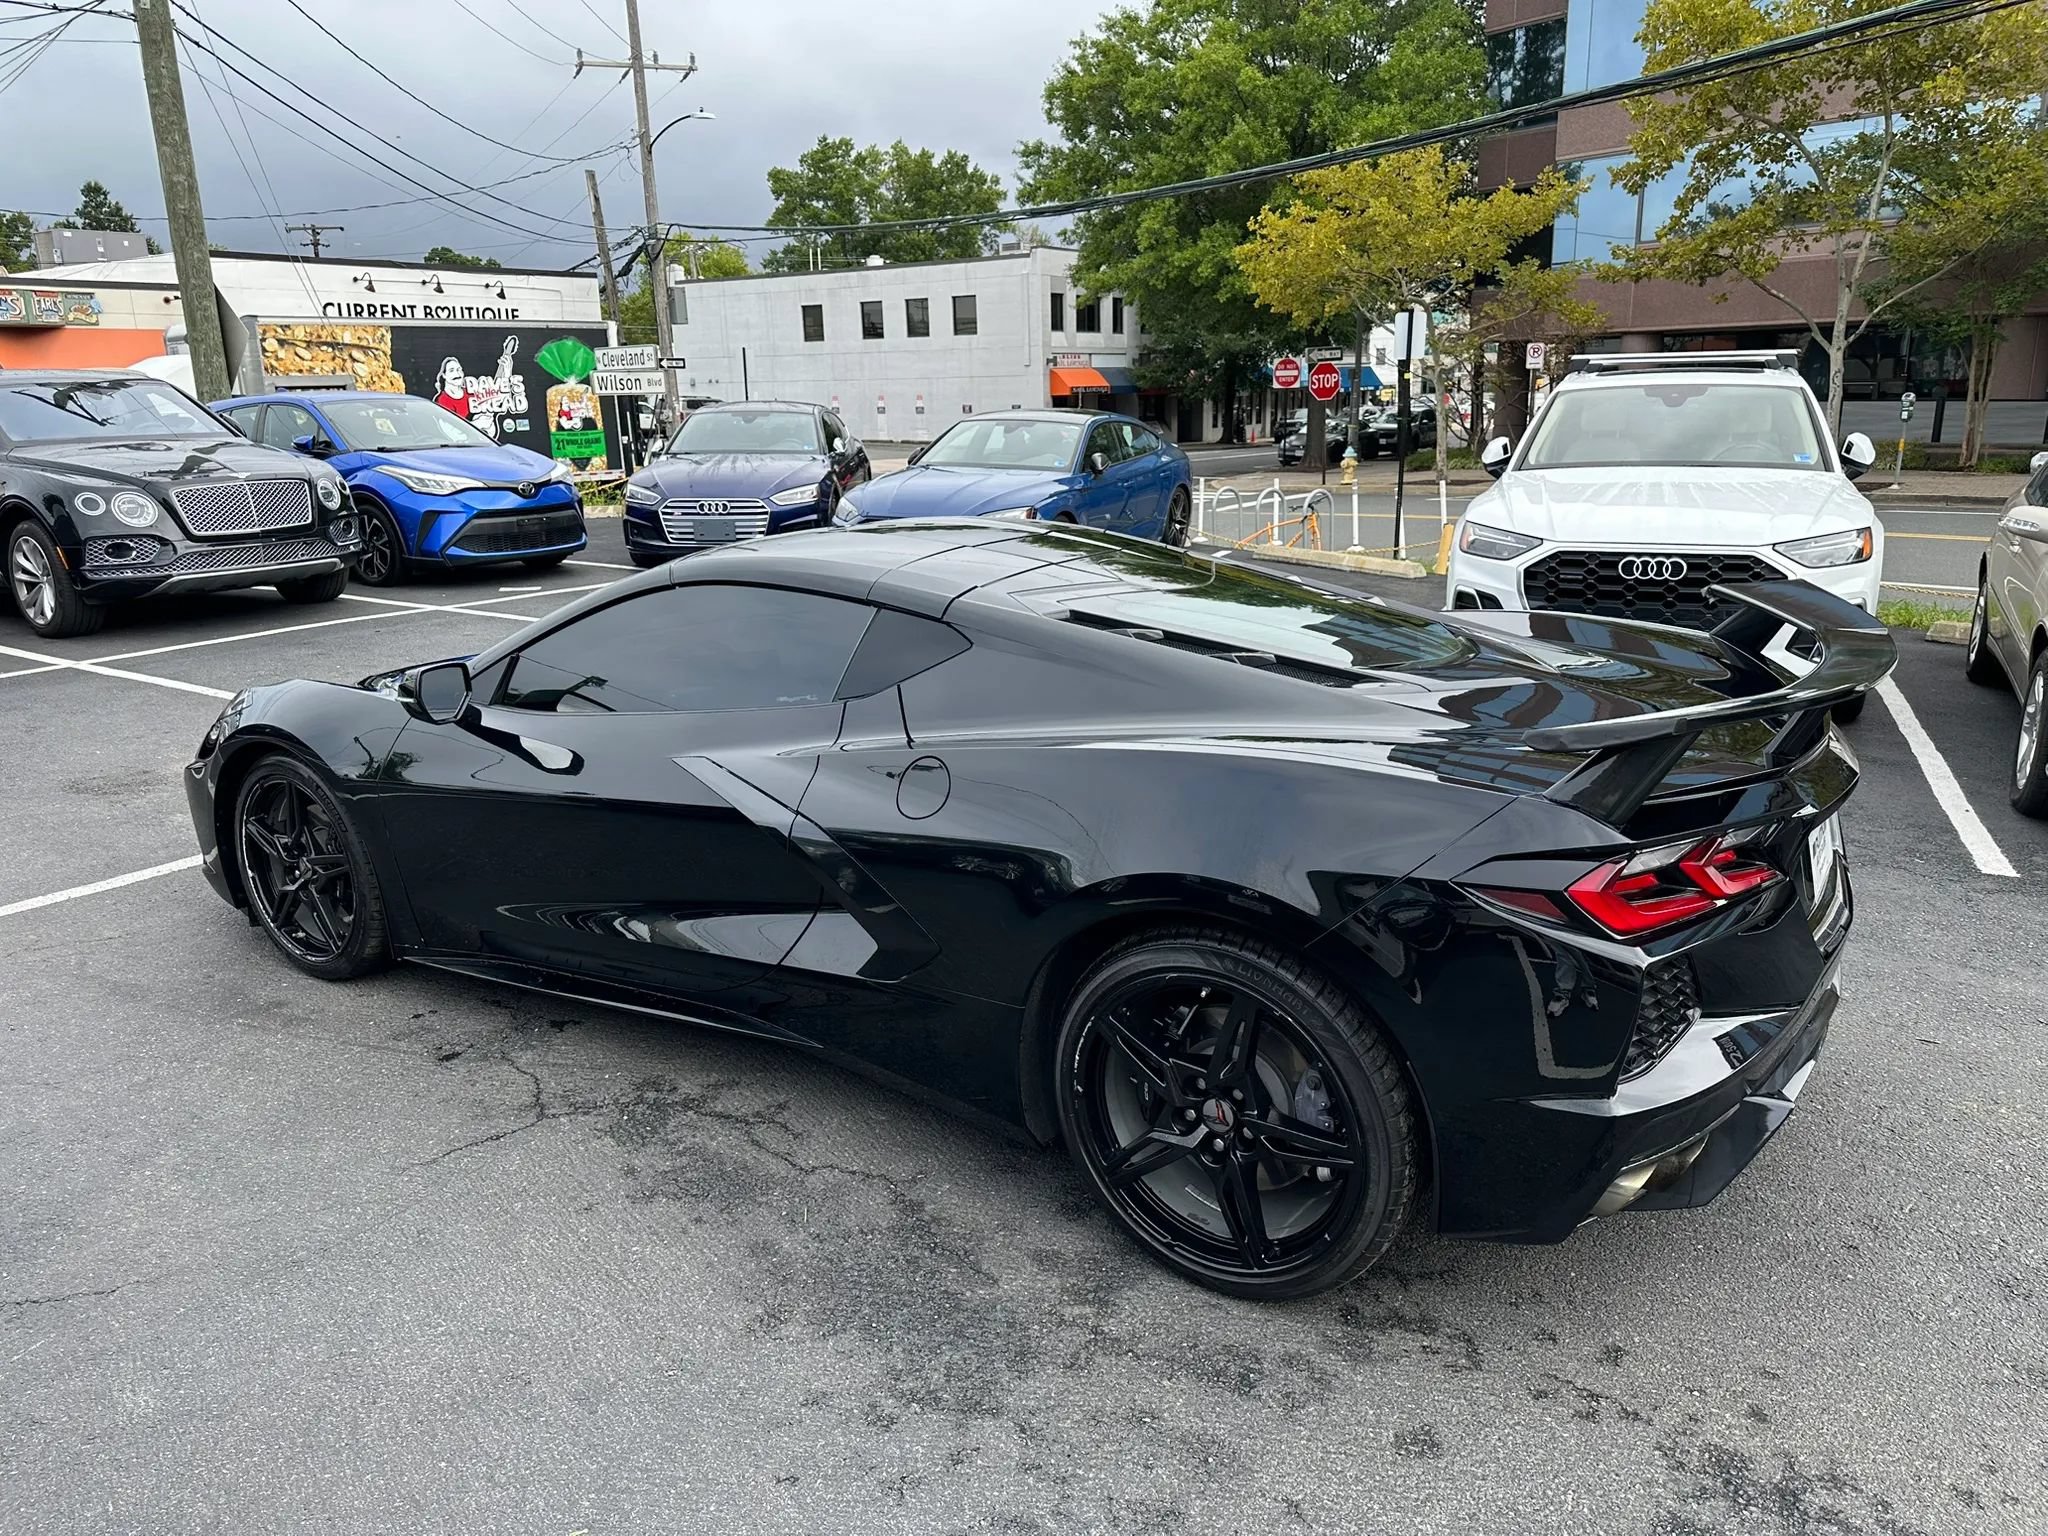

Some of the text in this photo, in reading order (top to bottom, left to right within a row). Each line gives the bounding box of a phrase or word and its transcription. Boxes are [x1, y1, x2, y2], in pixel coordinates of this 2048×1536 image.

[36, 298, 64, 317] EARL'S
[322, 302, 416, 319] CURRENT
[601, 349, 645, 367] Cleveland
[646, 352, 654, 361] St
[596, 374, 662, 391] Wilson Blvd
[1311, 373, 1338, 389] STOP
[468, 395, 528, 414] BREAD
[555, 438, 566, 450] 21
